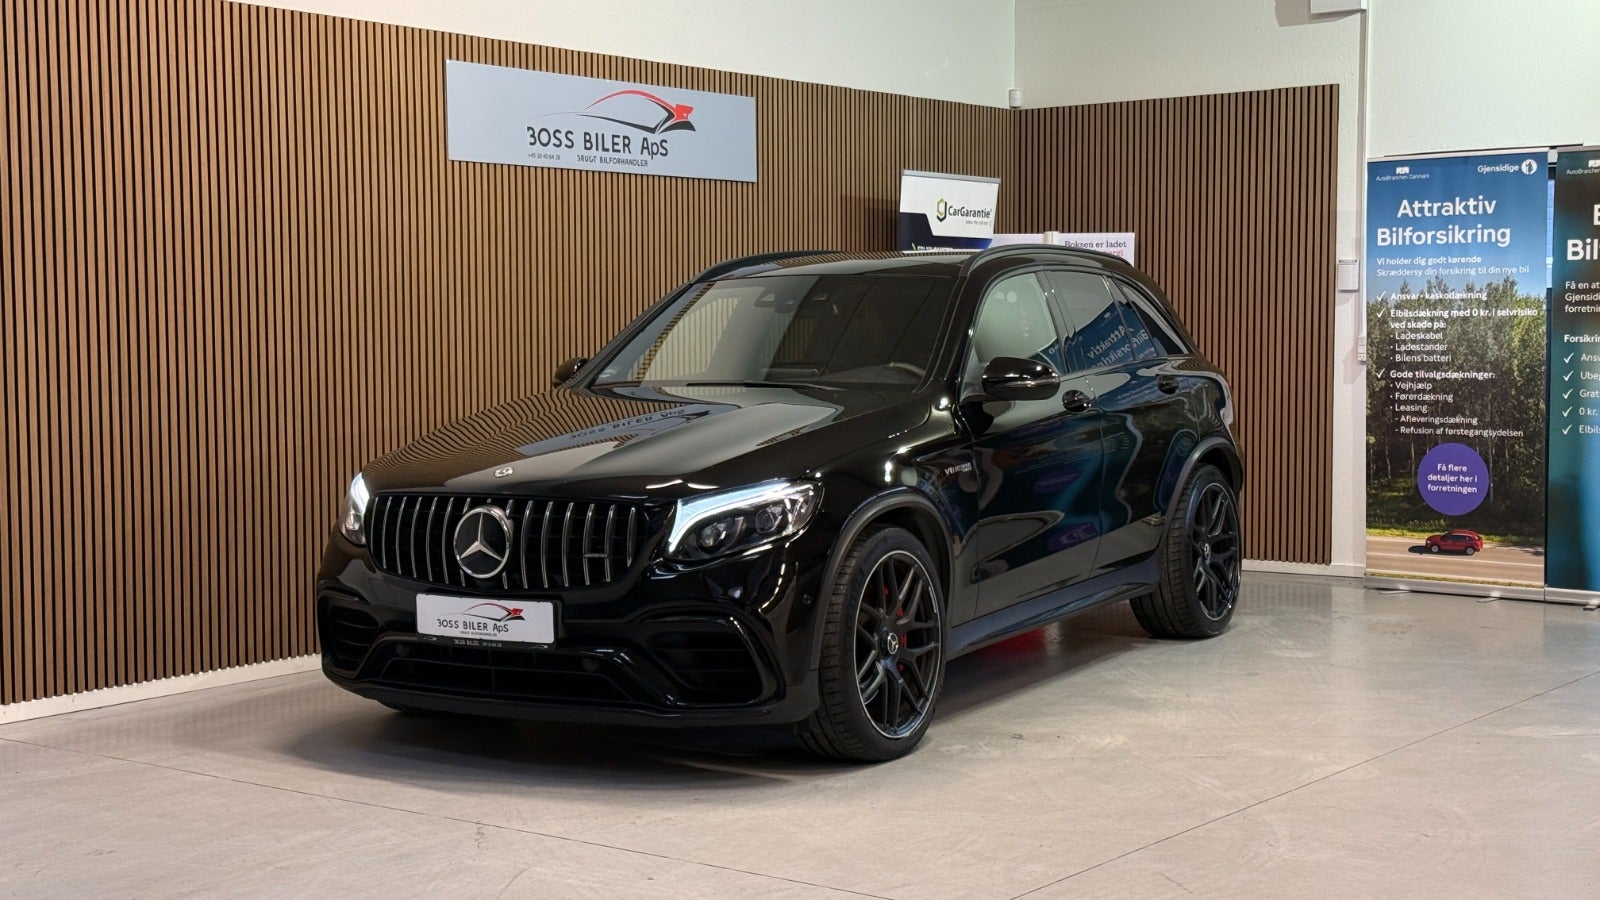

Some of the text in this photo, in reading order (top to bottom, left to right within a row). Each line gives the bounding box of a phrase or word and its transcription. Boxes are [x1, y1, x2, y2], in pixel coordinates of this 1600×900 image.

[527, 126, 669, 160] BOSS BILER ApS
[600, 156, 648, 167] BILFORHANDLER
[1478, 164, 1520, 174] Gjensidige
[1397, 195, 1497, 218] Attraktiv
[948, 206, 991, 218] CarGarantie
[1377, 224, 1511, 247] Bilforsikring
[1106, 240, 1127, 248] ladet
[1567, 238, 1600, 261] Bil
[1386, 257, 1412, 265] holder
[1414, 256, 1426, 266] dig
[1428, 256, 1447, 265] godt
[1376, 268, 1423, 277] Skræddersy
[1439, 266, 1476, 276] forsikring
[1478, 266, 1487, 274] til
[1488, 266, 1500, 274] din
[1502, 267, 1517, 275] nye
[1519, 265, 1530, 273] bil
[1566, 281, 1576, 289] Få
[1391, 290, 1487, 301] Ansvar- kaskodækning
[1391, 309, 1449, 318] Elbilsdækning
[1451, 308, 1470, 317] med
[1480, 308, 1491, 316] kr.
[1497, 308, 1538, 317] selvrisiko
[1407, 320, 1432, 328] skade
[1434, 320, 1446, 330] på:
[1396, 332, 1443, 340] Ladeskabel
[1396, 343, 1448, 351] Ladestander
[1396, 354, 1452, 362] Bilens batteri
[1390, 370, 1496, 380] Gode tilvalgsdækninger:
[1580, 371, 1600, 381] Ube
[1395, 382, 1432, 390] Vejhjælp
[1395, 392, 1454, 402] Førerdækning
[1579, 407, 1598, 416] 0 kr.
[1400, 415, 1478, 425] Afleveringsdækning
[1400, 426, 1524, 439] Refusion af førstegangsydelsen
[1448, 464, 1468, 472] flere
[1428, 474, 1458, 483] detaljer
[1428, 484, 1478, 494] forretningen
[437, 618, 459, 629] BOSS
[463, 621, 488, 632] BILER
[493, 623, 509, 634] ApS
